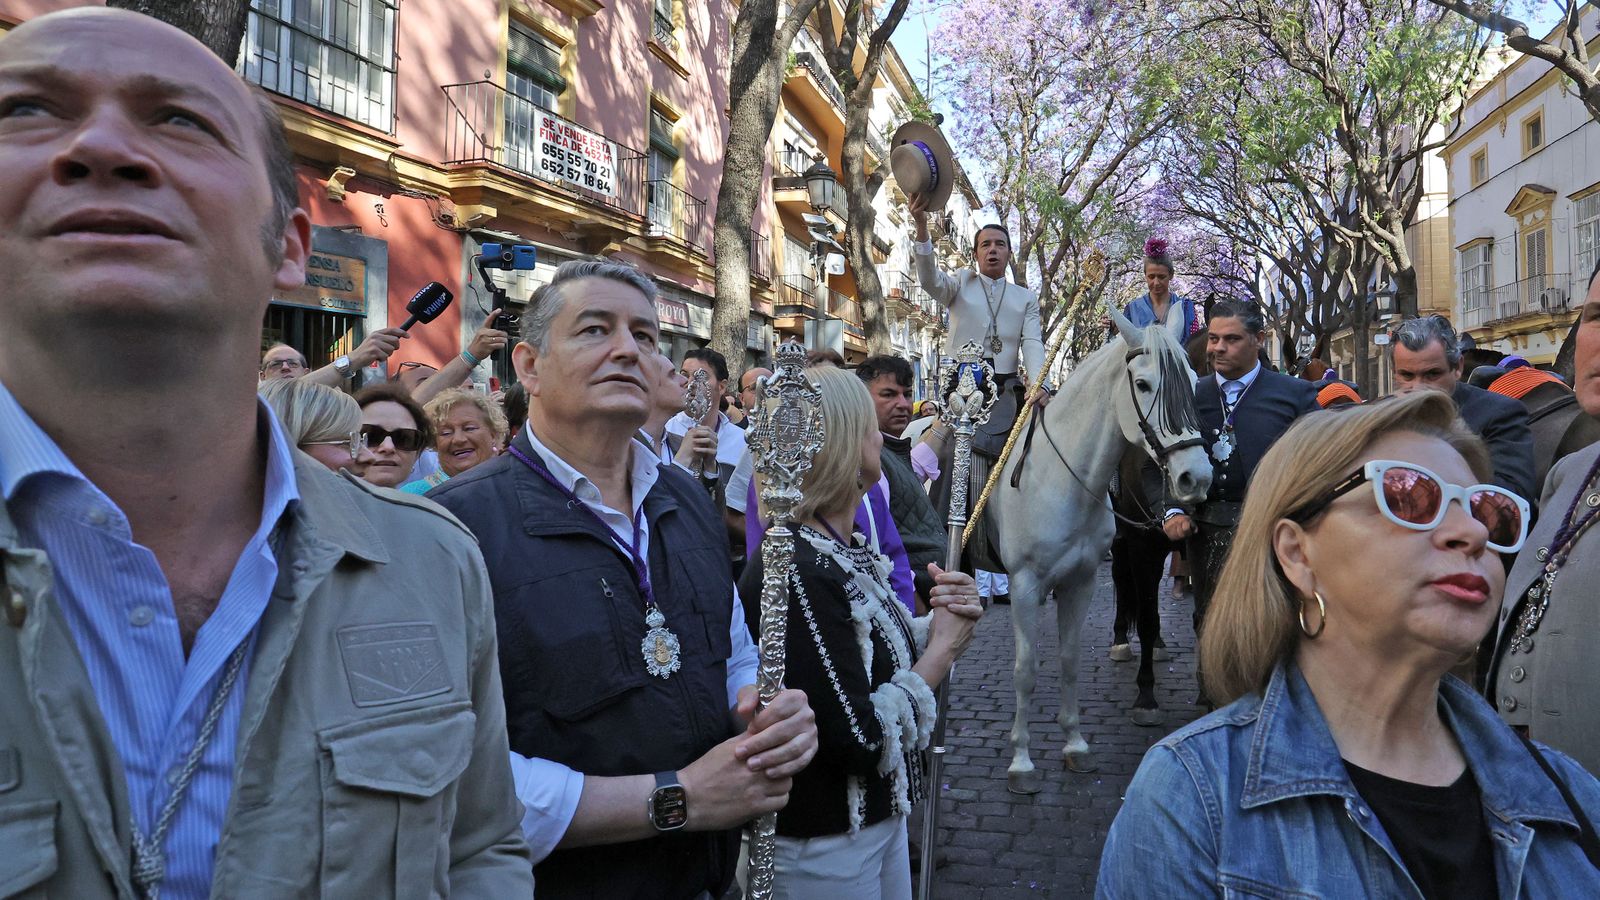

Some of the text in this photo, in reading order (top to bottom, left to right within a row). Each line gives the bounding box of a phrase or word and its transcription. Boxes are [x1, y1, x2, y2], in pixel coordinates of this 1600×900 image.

[539, 127, 568, 148] FINCA
[571, 141, 583, 154] DE
[585, 147, 601, 162] 452
[543, 117, 611, 155] SE VENDE ESTA
[541, 158, 611, 193] 652 57 18 84
[542, 142, 610, 179] 655 55 70 21
[655, 301, 685, 321] ROYO
